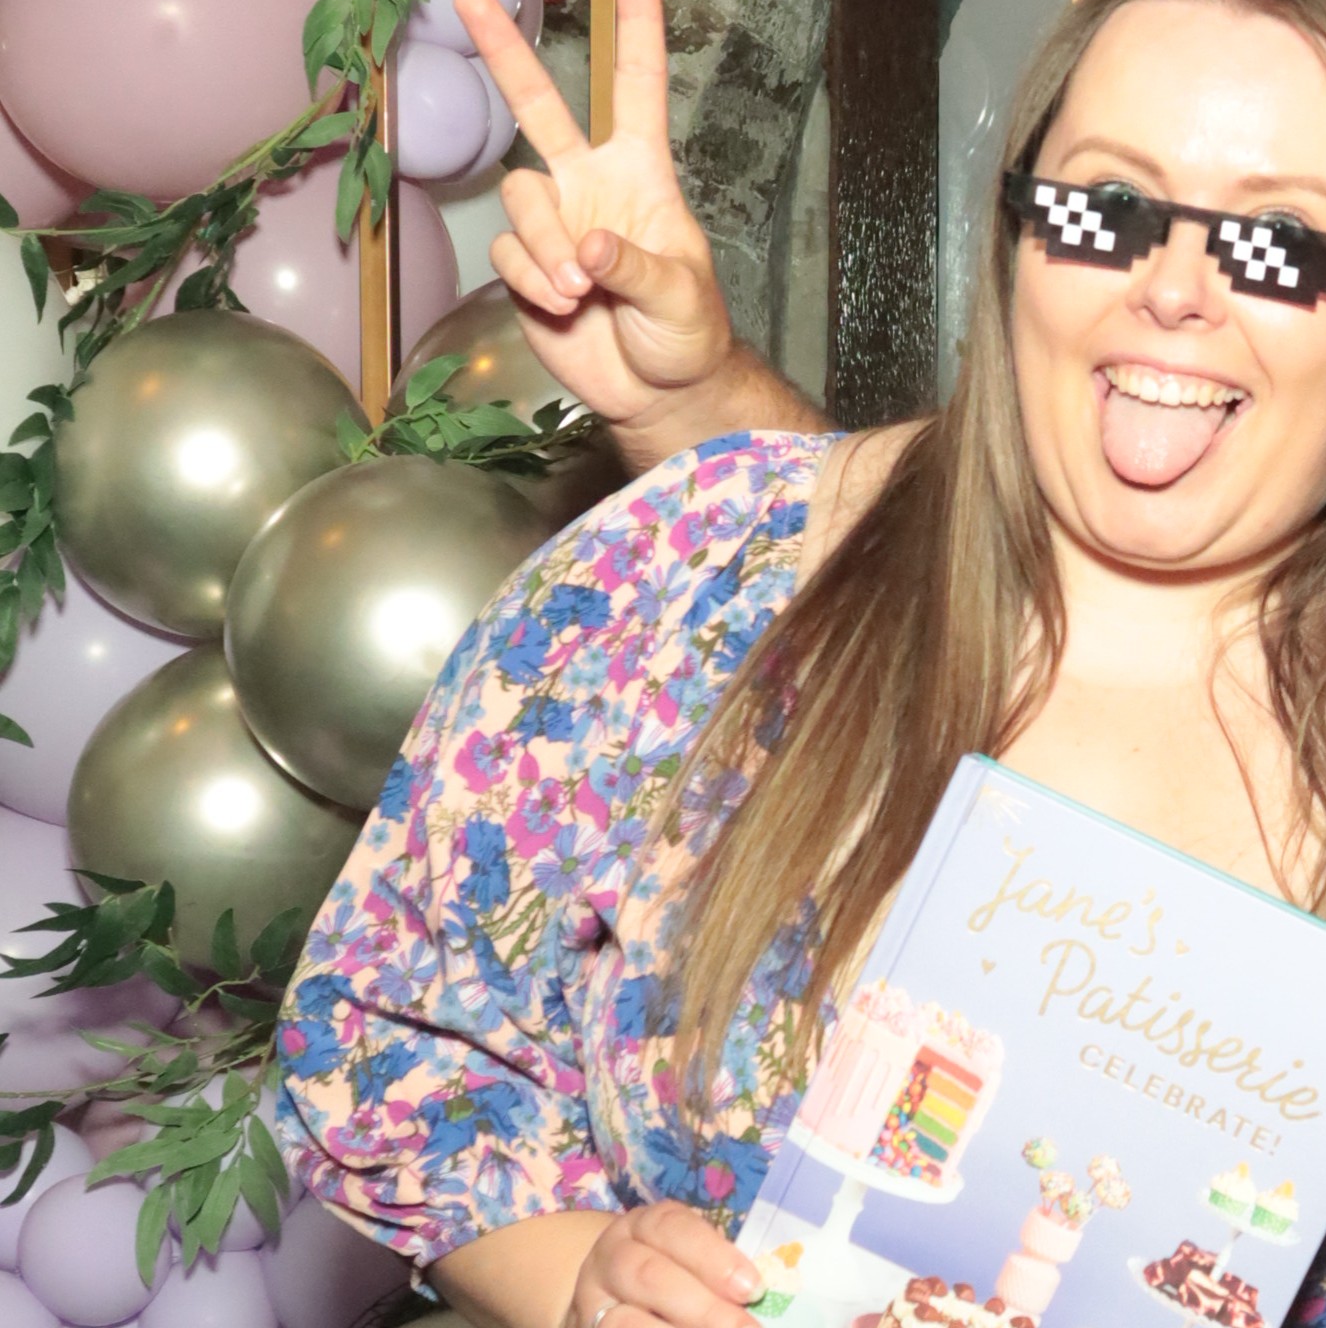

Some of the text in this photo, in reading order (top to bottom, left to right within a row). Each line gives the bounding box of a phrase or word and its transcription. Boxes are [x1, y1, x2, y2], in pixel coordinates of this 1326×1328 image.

[967, 836, 1163, 955] Jane's
[1038, 939, 1322, 1121] Patisserie
[1079, 1044, 1283, 1156] CELEBRATE!
